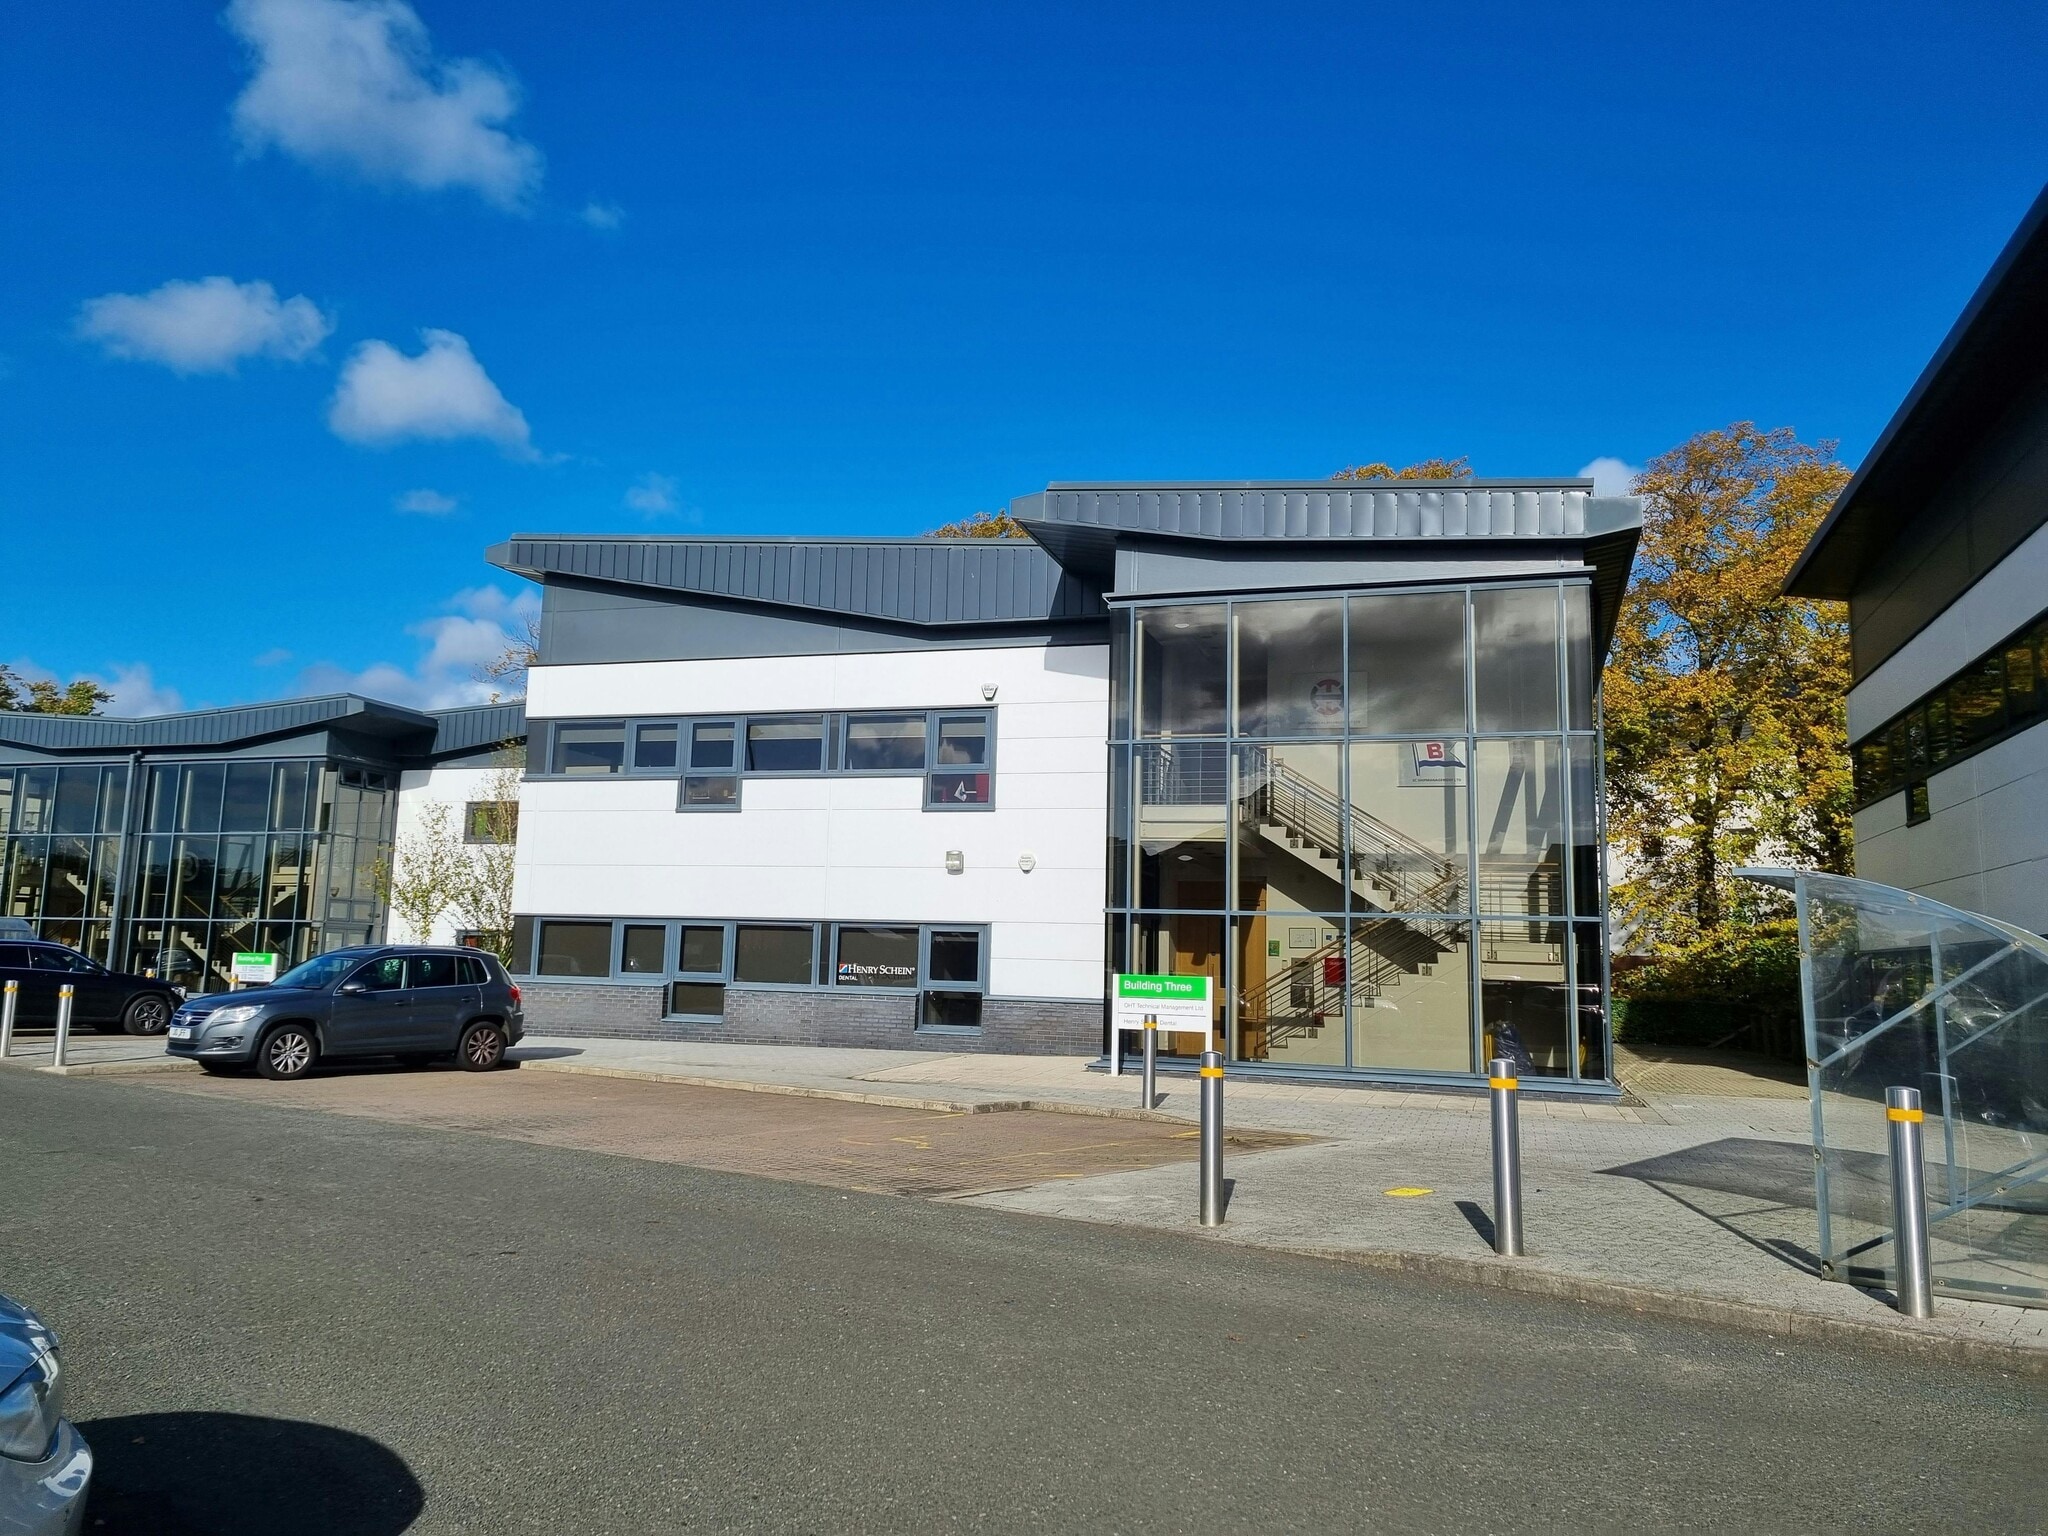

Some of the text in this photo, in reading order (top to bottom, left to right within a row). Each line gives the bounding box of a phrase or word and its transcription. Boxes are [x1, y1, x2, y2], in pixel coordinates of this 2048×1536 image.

[848, 964, 879, 975] HENRY
[1124, 980, 1192, 992] Building Three
